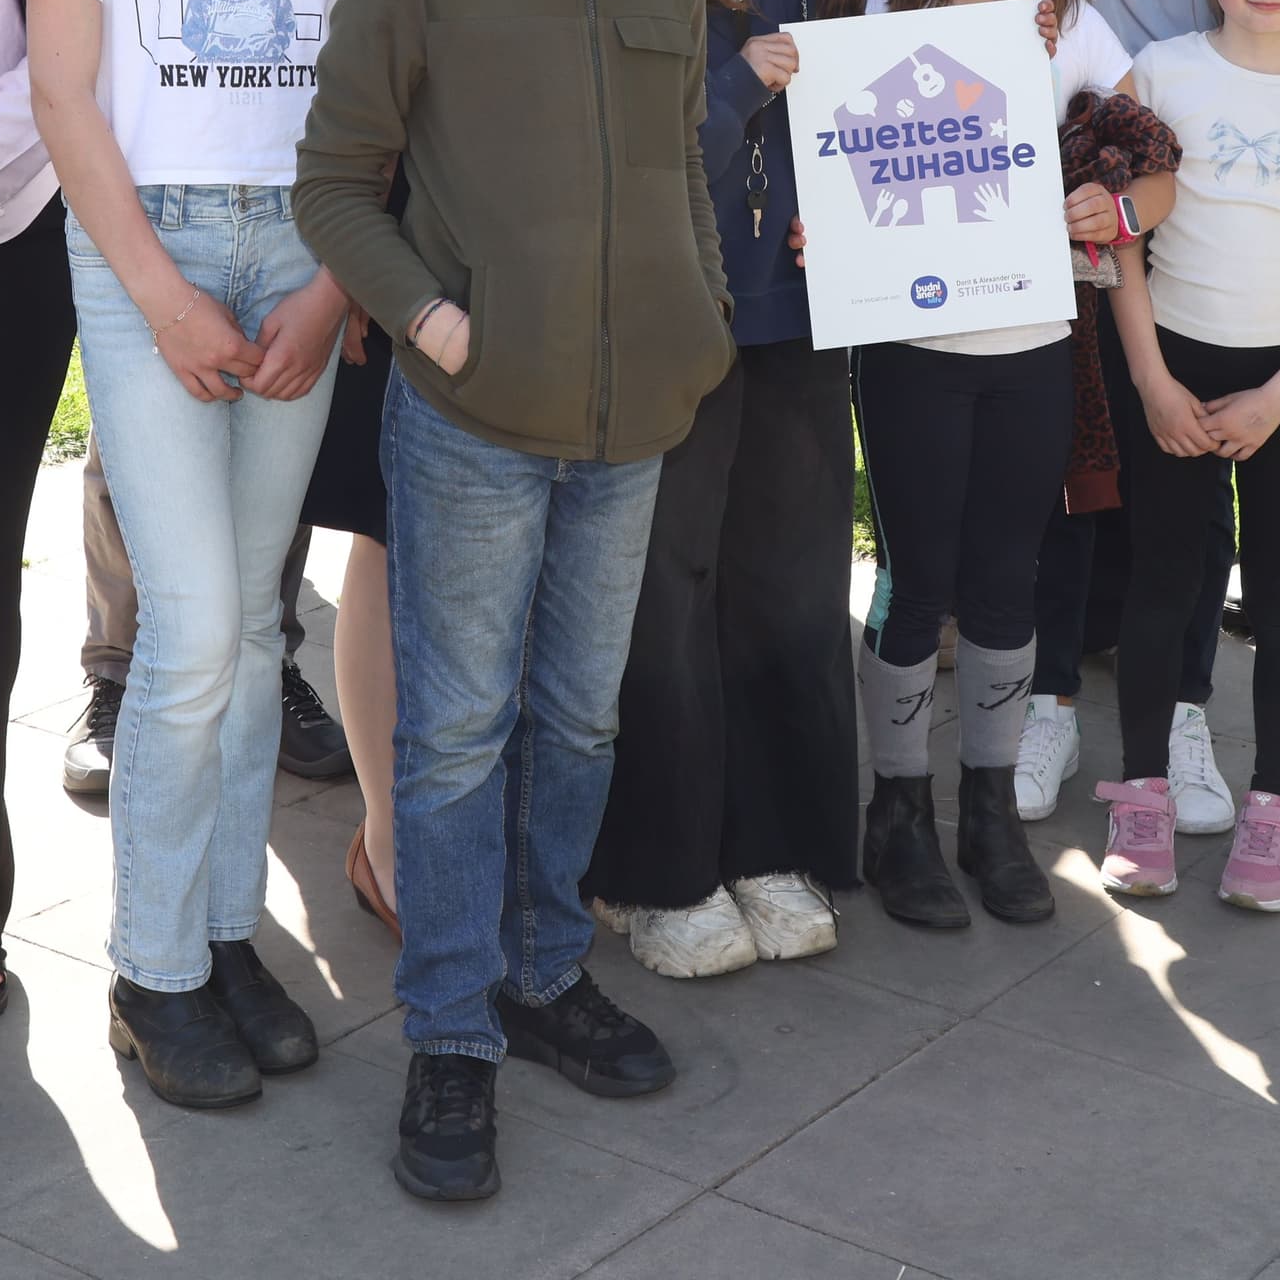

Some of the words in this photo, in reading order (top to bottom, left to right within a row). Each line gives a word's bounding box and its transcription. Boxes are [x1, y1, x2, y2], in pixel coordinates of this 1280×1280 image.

[159, 65, 209, 87] NEW
[216, 65, 272, 88] YORK
[278, 65, 317, 87] CITY
[979, 274, 1010, 284] Alexander
[1011, 272, 1026, 281] Otto
[958, 282, 1010, 298] STIFTUNG
